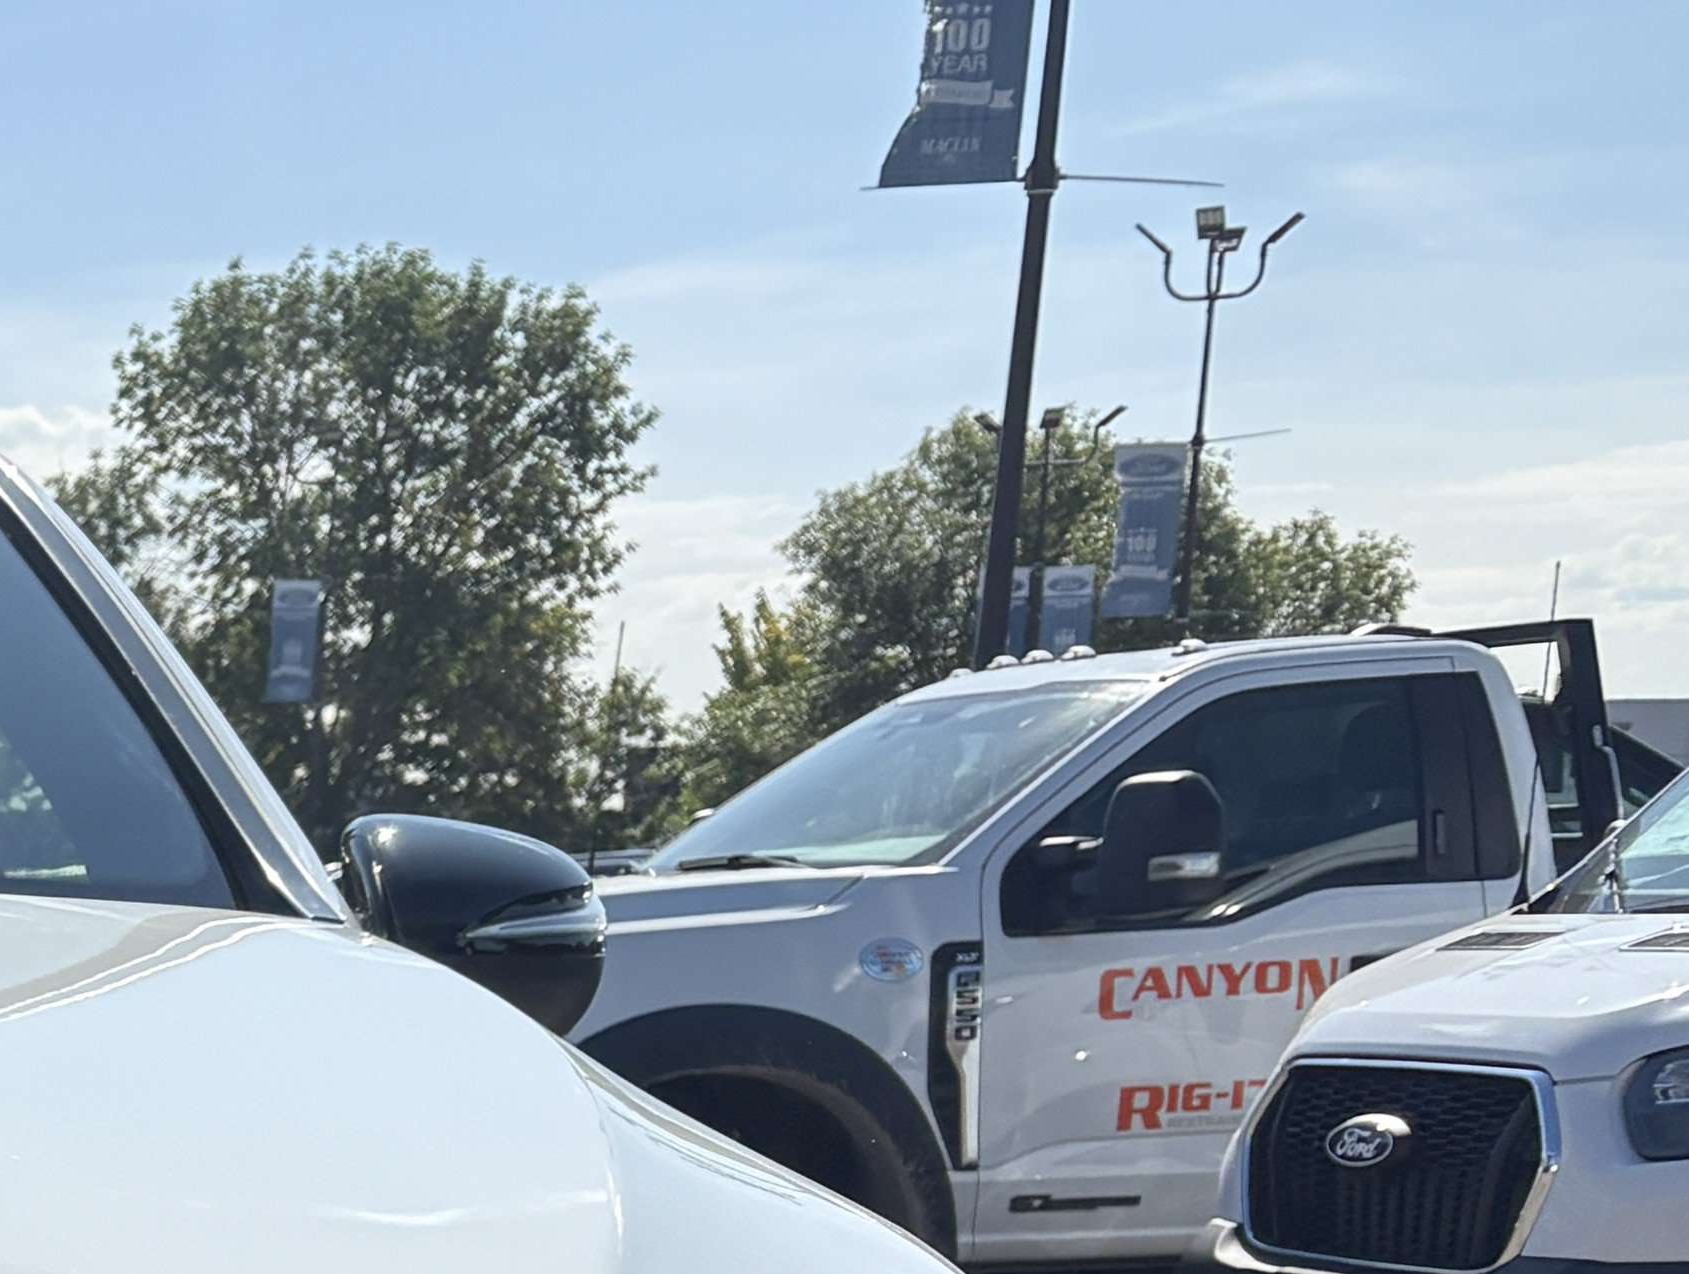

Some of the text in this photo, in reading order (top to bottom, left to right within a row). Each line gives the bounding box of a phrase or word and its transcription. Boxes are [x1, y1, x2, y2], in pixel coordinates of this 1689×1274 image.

[931, 18, 991, 54] 100
[930, 53, 989, 75] YEAR
[1098, 956, 1339, 1020] CANYON
[1335, 1127, 1383, 1159] Ford
